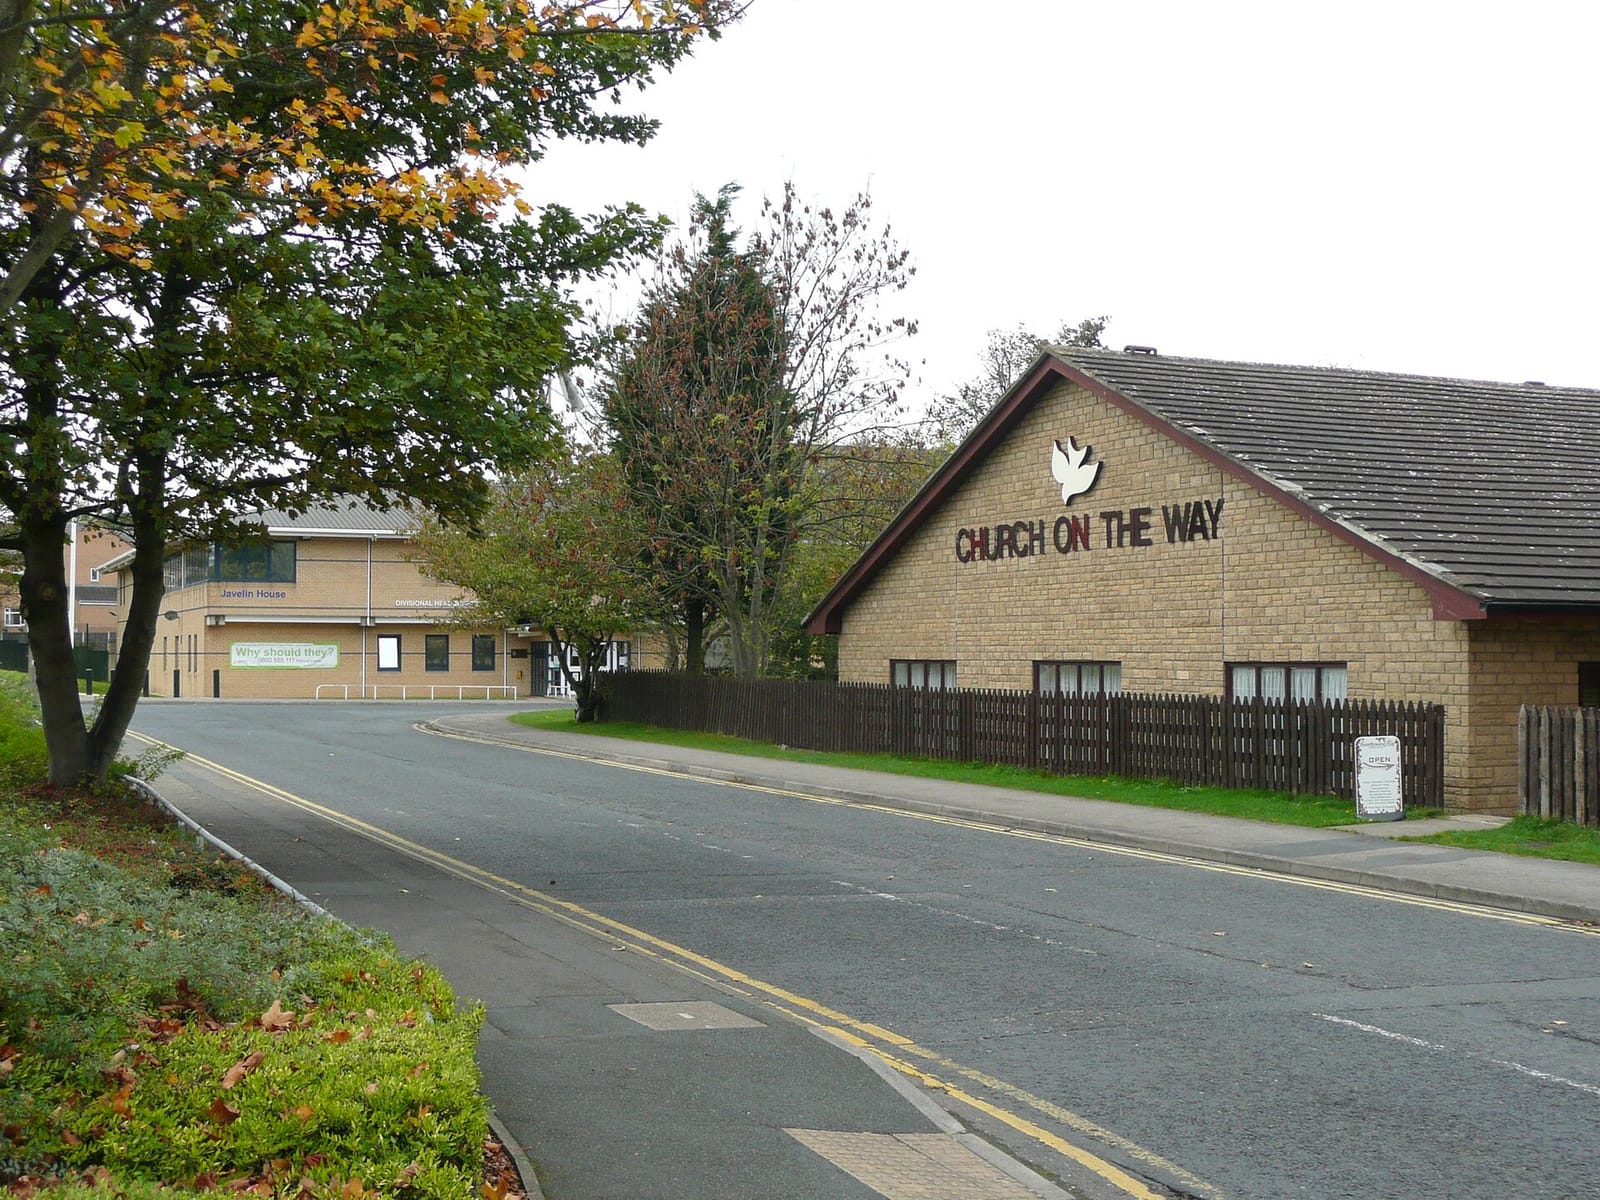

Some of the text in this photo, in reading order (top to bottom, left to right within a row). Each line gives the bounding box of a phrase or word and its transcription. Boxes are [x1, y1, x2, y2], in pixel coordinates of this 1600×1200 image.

[956, 498, 1225, 563] CHURCH ON THE WAY
[221, 590, 286, 598] Javelin House
[395, 600, 433, 608] DIVISIONAL
[236, 648, 334, 658] Why should they?
